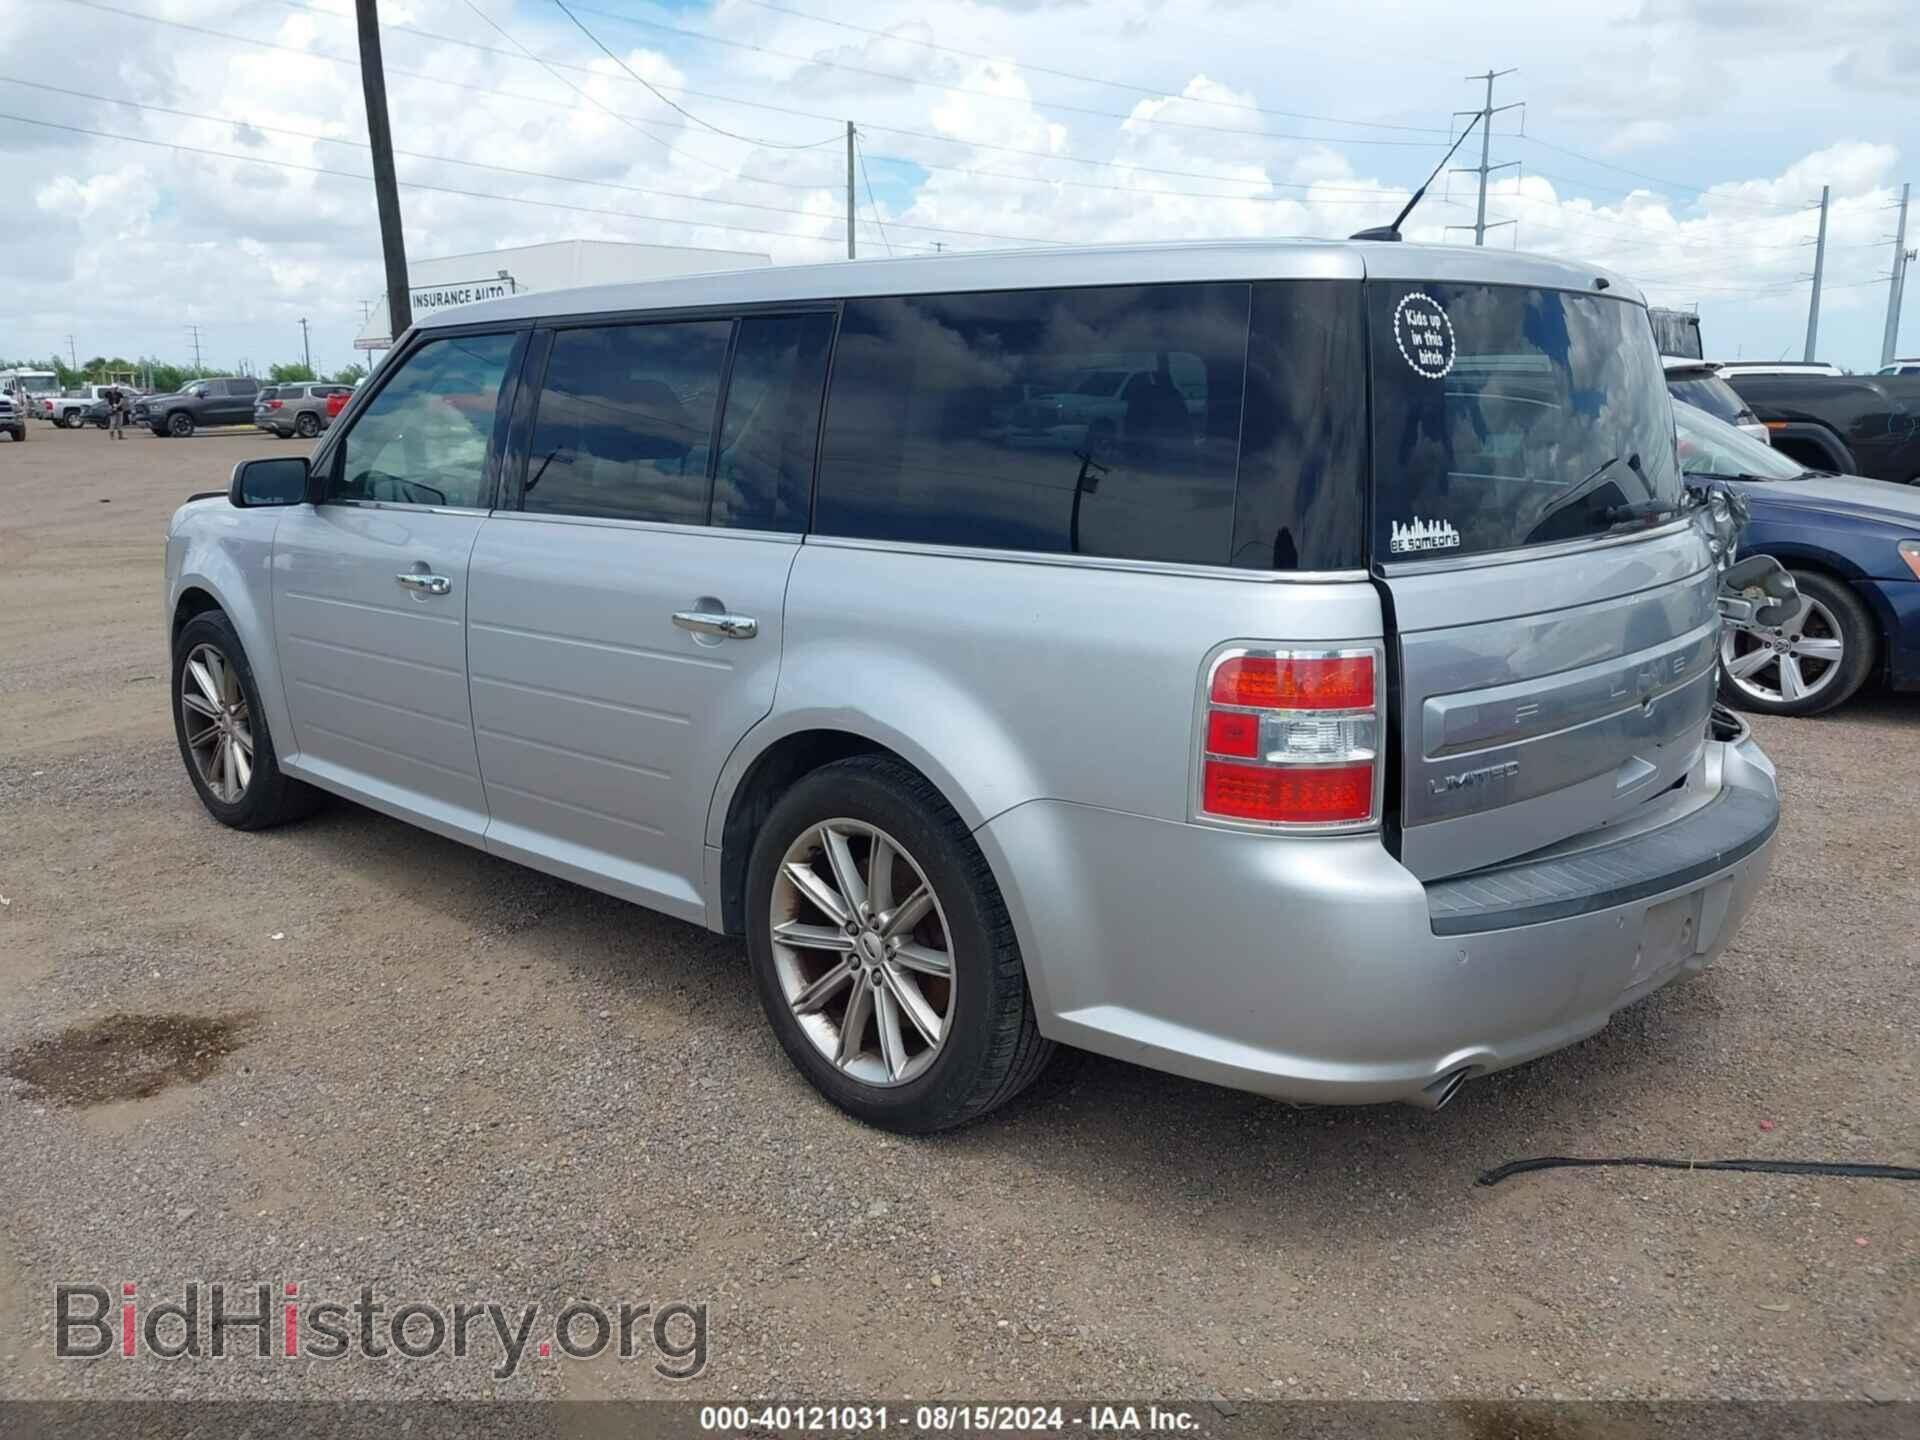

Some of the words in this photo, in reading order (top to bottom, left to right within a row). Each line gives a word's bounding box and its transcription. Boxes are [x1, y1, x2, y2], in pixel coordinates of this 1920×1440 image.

[412, 289, 471, 308] INSURANCE
[475, 285, 504, 301] AUTO
[1405, 309, 1428, 326] Kids
[1429, 315, 1441, 330] up
[1411, 329, 1422, 345] in
[1424, 330, 1443, 346] this
[1419, 348, 1444, 365] bitch
[1391, 539, 1405, 552] BE
[1512, 655, 1687, 724] FLE
[1430, 761, 1519, 794] LIMITED
